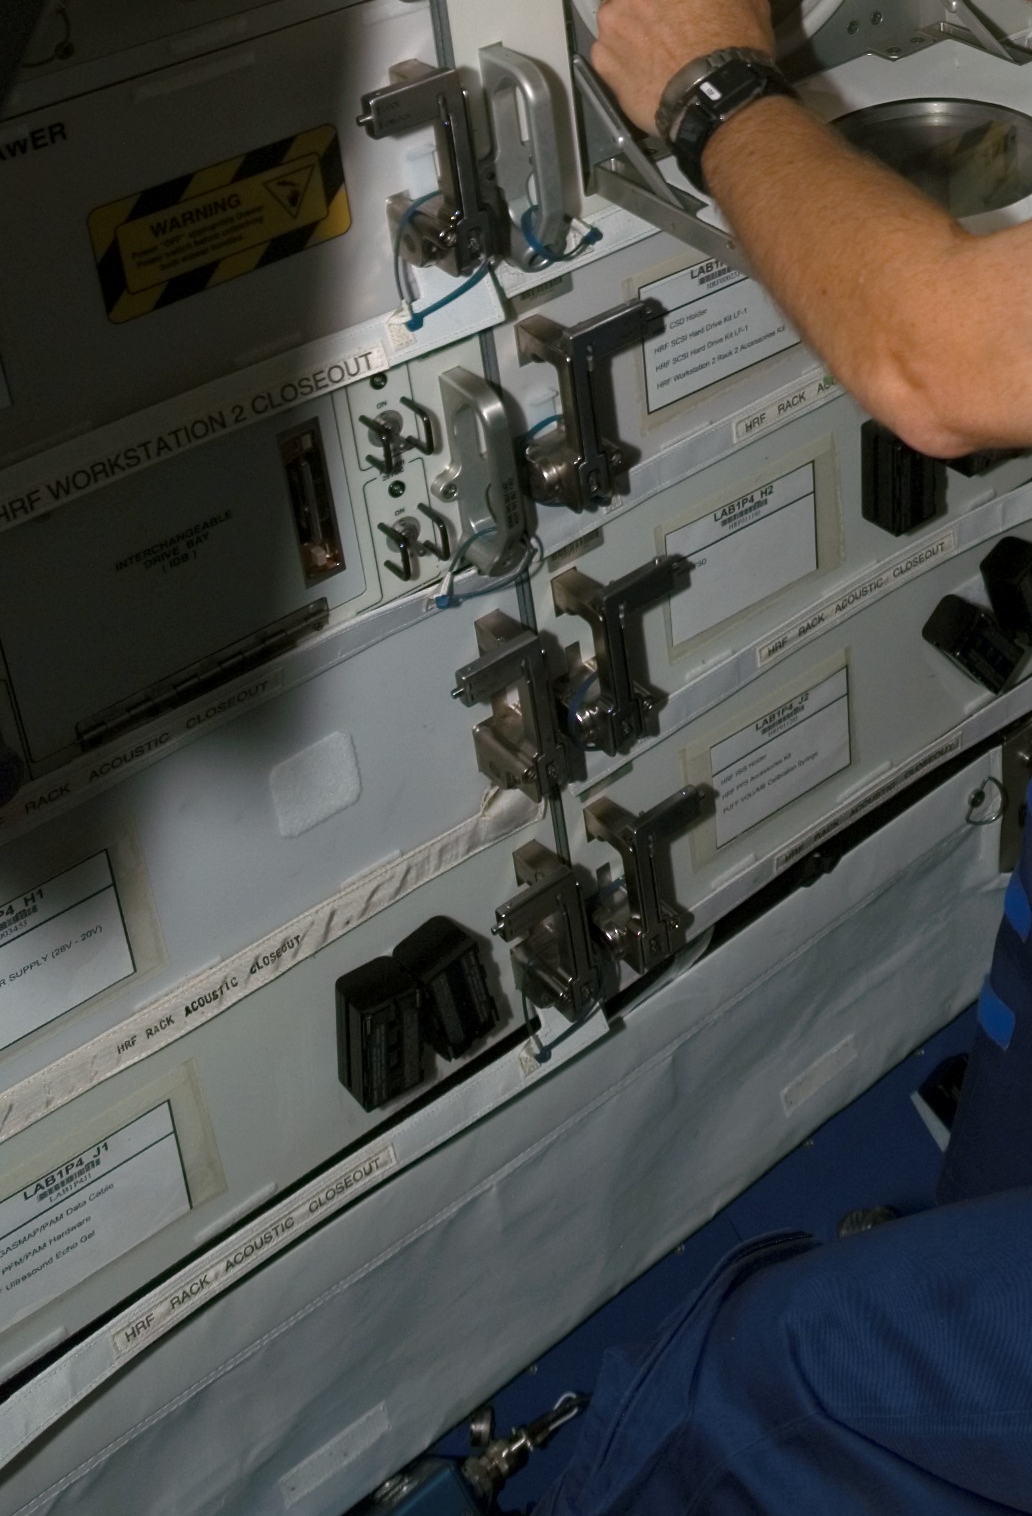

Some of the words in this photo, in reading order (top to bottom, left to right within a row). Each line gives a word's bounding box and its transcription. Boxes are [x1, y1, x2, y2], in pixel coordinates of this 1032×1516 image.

[150, 192, 243, 238] WARNING
[653, 341, 671, 355] HRF
[669, 333, 689, 349] SCSI
[688, 326, 706, 341] Hard
[705, 318, 724, 333] Drive
[723, 313, 733, 324] Kit
[733, 307, 749, 321] LF-1
[655, 359, 671, 373] HRF
[671, 352, 690, 367] SCSI
[689, 344, 707, 359] Hard
[706, 336, 725, 351] Drive
[724, 330, 735, 342] Kit
[734, 324, 749, 338] LF-1
[656, 376, 672, 390] HRF
[672, 361, 711, 384] Workstation
[711, 357, 718, 367] 2
[716, 350, 734, 364] Rack
[734, 347, 740, 356] 2
[739, 330, 777, 354] Accessories
[776, 325, 786, 336] Kit
[46, 410, 227, 502] WORKSTATION
[231, 403, 248, 424] 2
[251, 351, 374, 416] CLOSEOUT
[376, 399, 389, 410] ON
[745, 412, 767, 434] HRF
[777, 391, 807, 416] RACK
[393, 506, 407, 517] ON
[713, 494, 755, 523] LAB1P4
[760, 484, 775, 499] H2
[115, 509, 234, 572] INTERCHANGEABLE
[143, 546, 181, 571] DRIVE
[187, 531, 211, 551] BAY
[767, 636, 789, 657] HRF
[798, 612, 826, 637] RACK
[834, 576, 884, 615] ACOUSTIC
[892, 541, 946, 580] CLOSEOUT
[755, 702, 794, 732] LAB1P4
[798, 692, 811, 705] J2
[24, 782, 72, 815] RACK
[88, 732, 171, 783] ACOUSTIC
[185, 679, 269, 730] CLOSEOUT
[722, 798, 740, 814] PUFF
[740, 782, 767, 803] VOLUME
[767, 764, 798, 786] Calibration
[797, 751, 819, 768] Syringe
[23, 888, 45, 907] H1
[116, 1035, 137, 1055] HRF
[145, 1014, 175, 1039] RACK
[184, 976, 239, 1018] ACOUSTIC
[250, 934, 301, 975] CLOSEOUT
[23, 1156, 85, 1201] LAB1P4
[92, 1141, 110, 1159] J1
[1, 1241, 47, 1276] PFM/PAM
[49, 1215, 92, 1246] Hardware
[5, 1256, 54, 1292] Ultrasound
[55, 1241, 78, 1260] Echo
[79, 1229, 96, 1245] Gel
[124, 1312, 155, 1344] HRF
[169, 1274, 212, 1310] RACK
[223, 1215, 296, 1274] ACOUSTIC
[307, 1156, 381, 1215] CLOSEOUT
